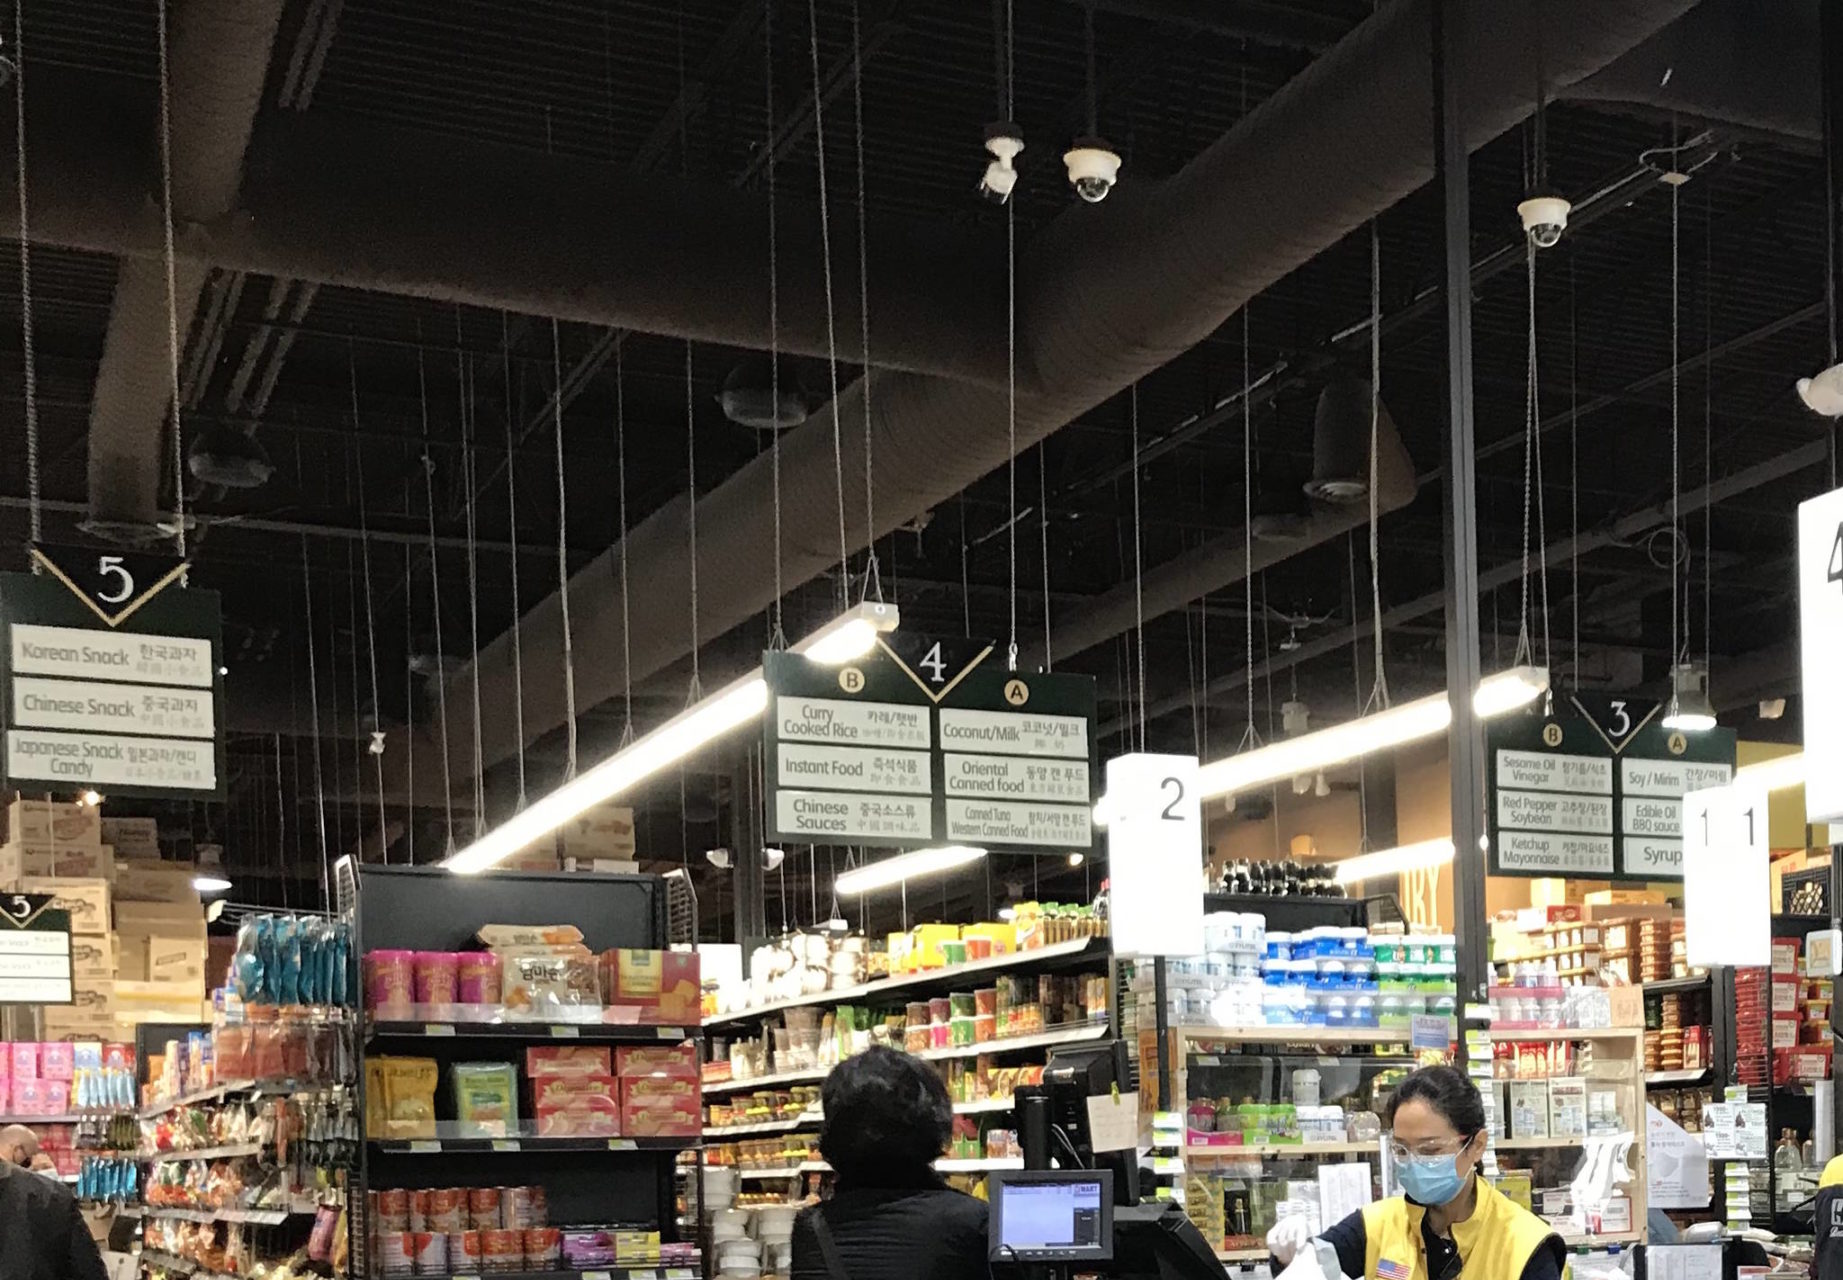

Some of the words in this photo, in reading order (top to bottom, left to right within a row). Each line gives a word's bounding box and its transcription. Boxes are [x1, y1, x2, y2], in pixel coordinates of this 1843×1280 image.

[97, 556, 134, 603] 5
[21, 642, 78, 661] Korean
[83, 646, 130, 666] Snack
[139, 643, 197, 662] 한국과자
[919, 641, 947, 682] 4
[23, 694, 84, 714] Chinese
[88, 699, 136, 718] Snack
[802, 704, 834, 723] Curry
[784, 719, 830, 736] Cooked
[833, 722, 858, 738] Rice
[1608, 701, 1631, 738] 3
[943, 722, 1020, 741] Coconut/Milk
[15, 739, 79, 760] Japanese
[83, 741, 125, 760] Snack
[50, 758, 94, 778] Candy
[785, 758, 829, 775] Instant
[832, 760, 863, 776] Food
[962, 760, 1009, 777] Oriental
[1504, 756, 1542, 770] Sesame
[1543, 759, 1556, 770] Oil
[949, 775, 995, 792] Canned
[997, 778, 1025, 793] food
[1512, 769, 1550, 785] Vinegar
[1629, 771, 1646, 788] Soy
[793, 798, 849, 815] Chinese
[1160, 776, 1186, 821] 2
[1503, 796, 1522, 809] Red
[1523, 798, 1557, 813] Pepper
[965, 806, 993, 820] Canned
[994, 807, 1011, 821] Tuna
[1511, 811, 1552, 826] Soybean
[1636, 805, 1663, 818] Edible
[1664, 806, 1676, 819] Oil
[796, 815, 847, 831] Sauces
[951, 821, 981, 835] Western
[982, 822, 1009, 837] Canned
[1011, 823, 1029, 838] Food
[1633, 819, 1652, 832] BBQ
[1654, 821, 1680, 833] sauce
[1743, 806, 1755, 846] 1
[1511, 837, 1550, 852] Ketchup
[1504, 850, 1560, 866] Mayonnaise
[1644, 846, 1682, 866] Syrup
[11, 895, 32, 918] 5
